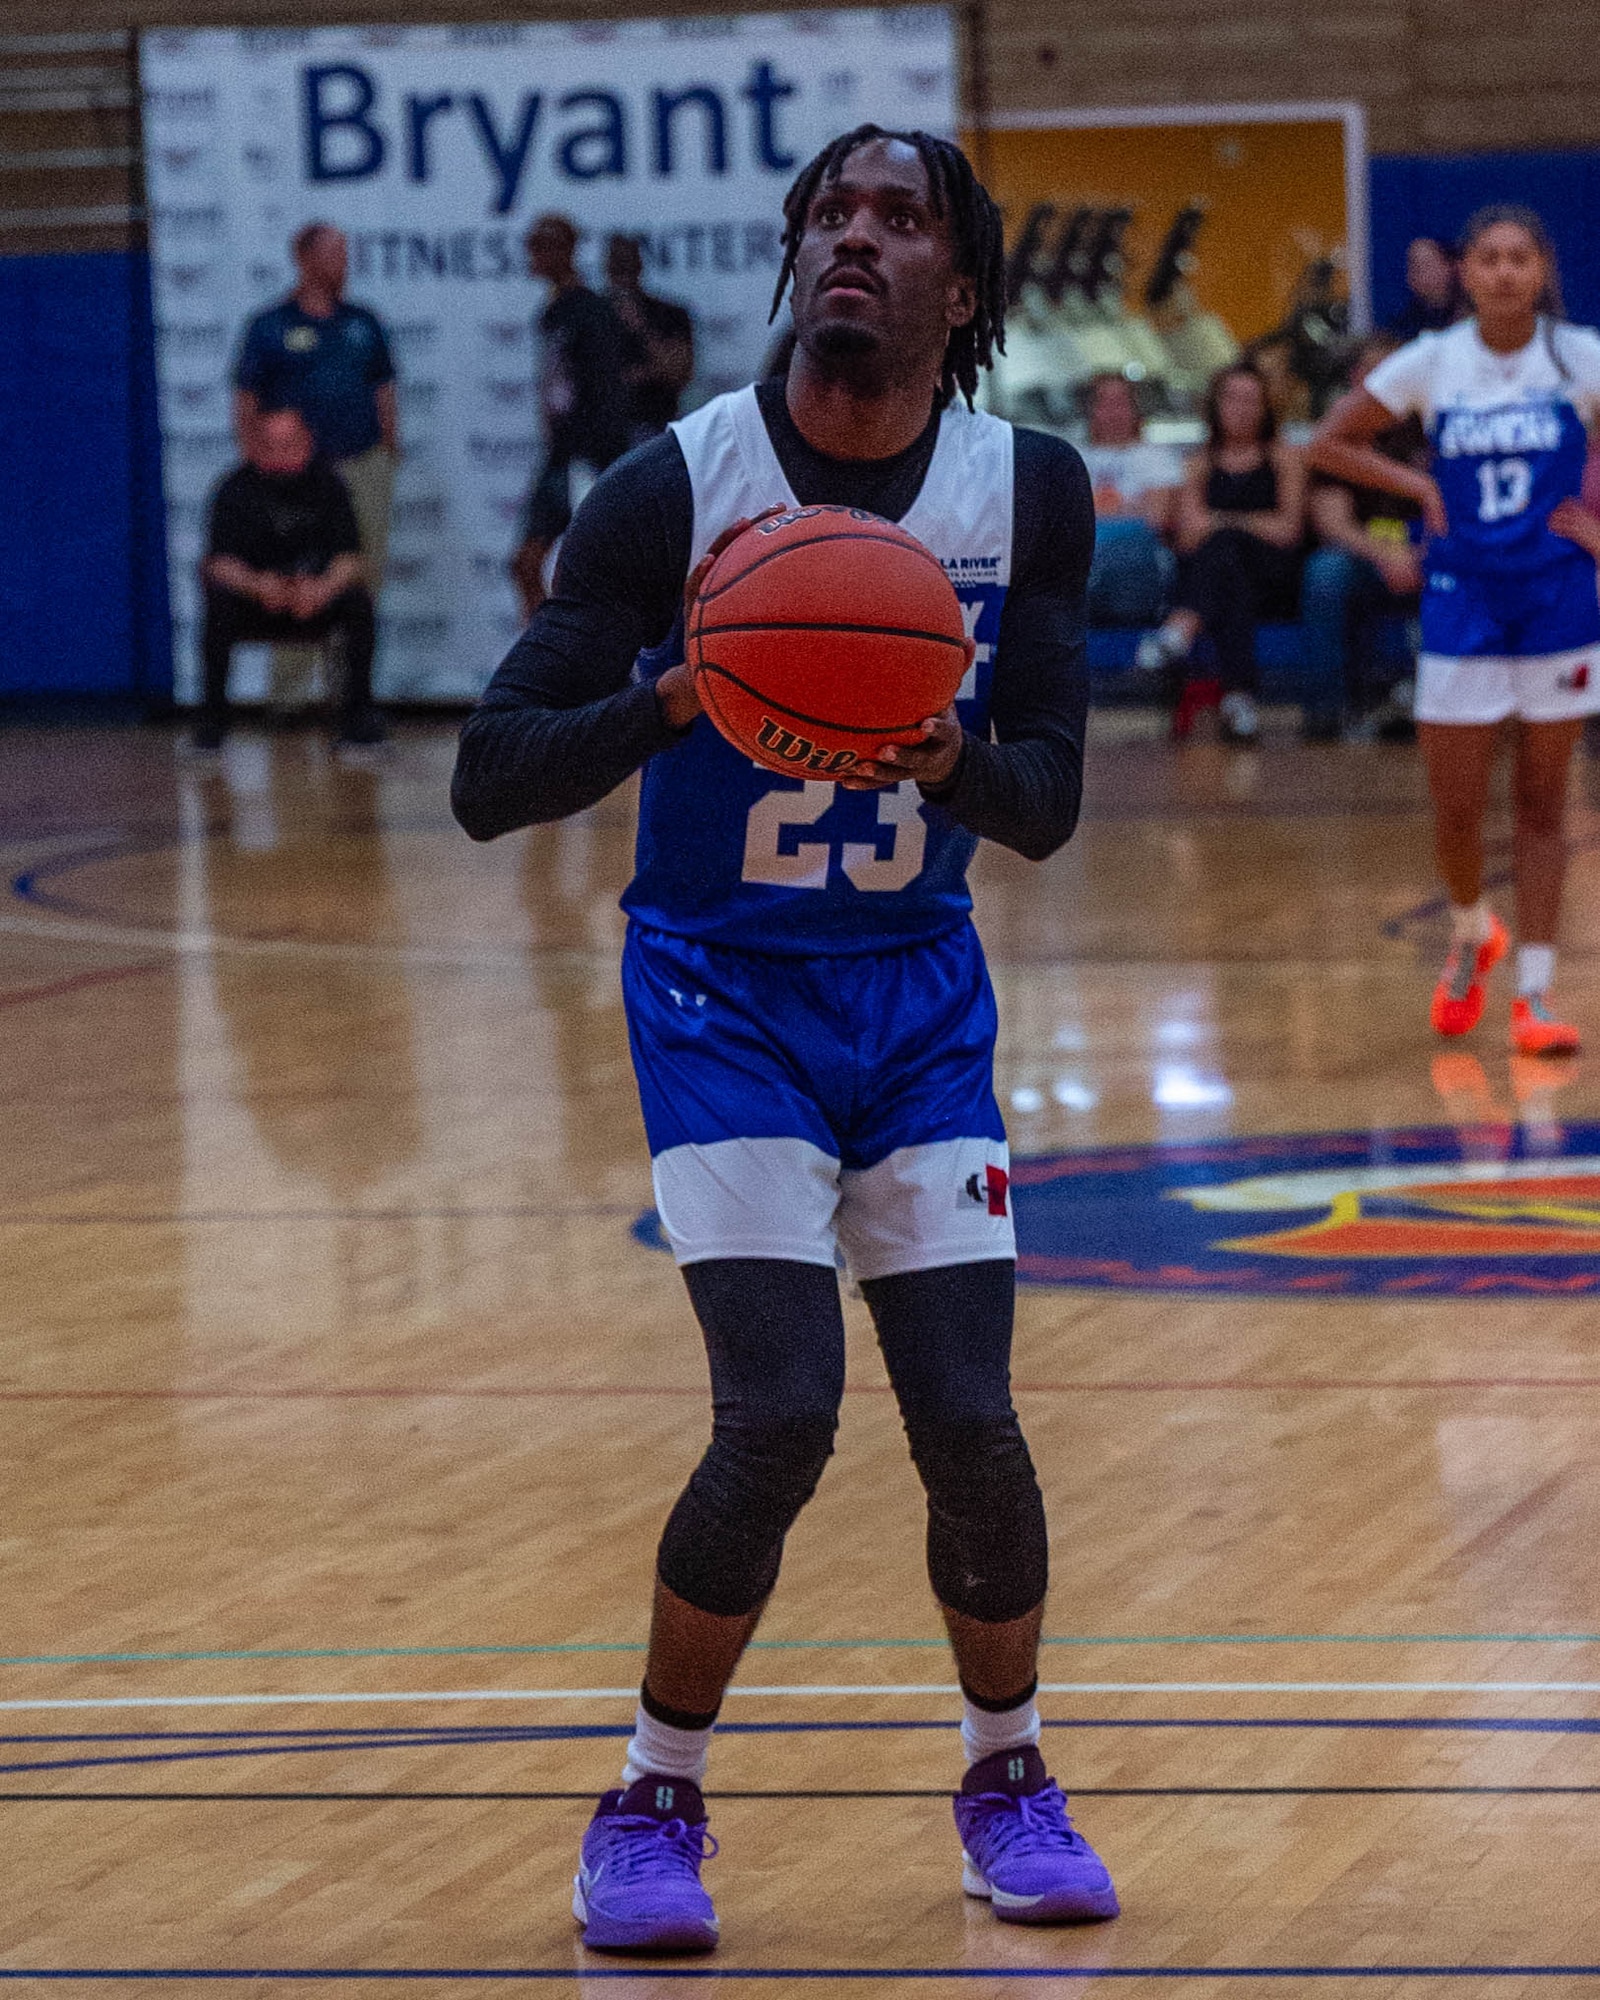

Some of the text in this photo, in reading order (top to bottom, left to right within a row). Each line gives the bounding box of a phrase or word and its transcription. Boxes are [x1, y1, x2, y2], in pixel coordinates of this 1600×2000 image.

[302, 58, 797, 216] Bryant
[351, 230, 520, 283] ITNES
[940, 558, 958, 570] LA
[756, 715, 858, 774] Wil
[741, 768, 928, 892] 23
